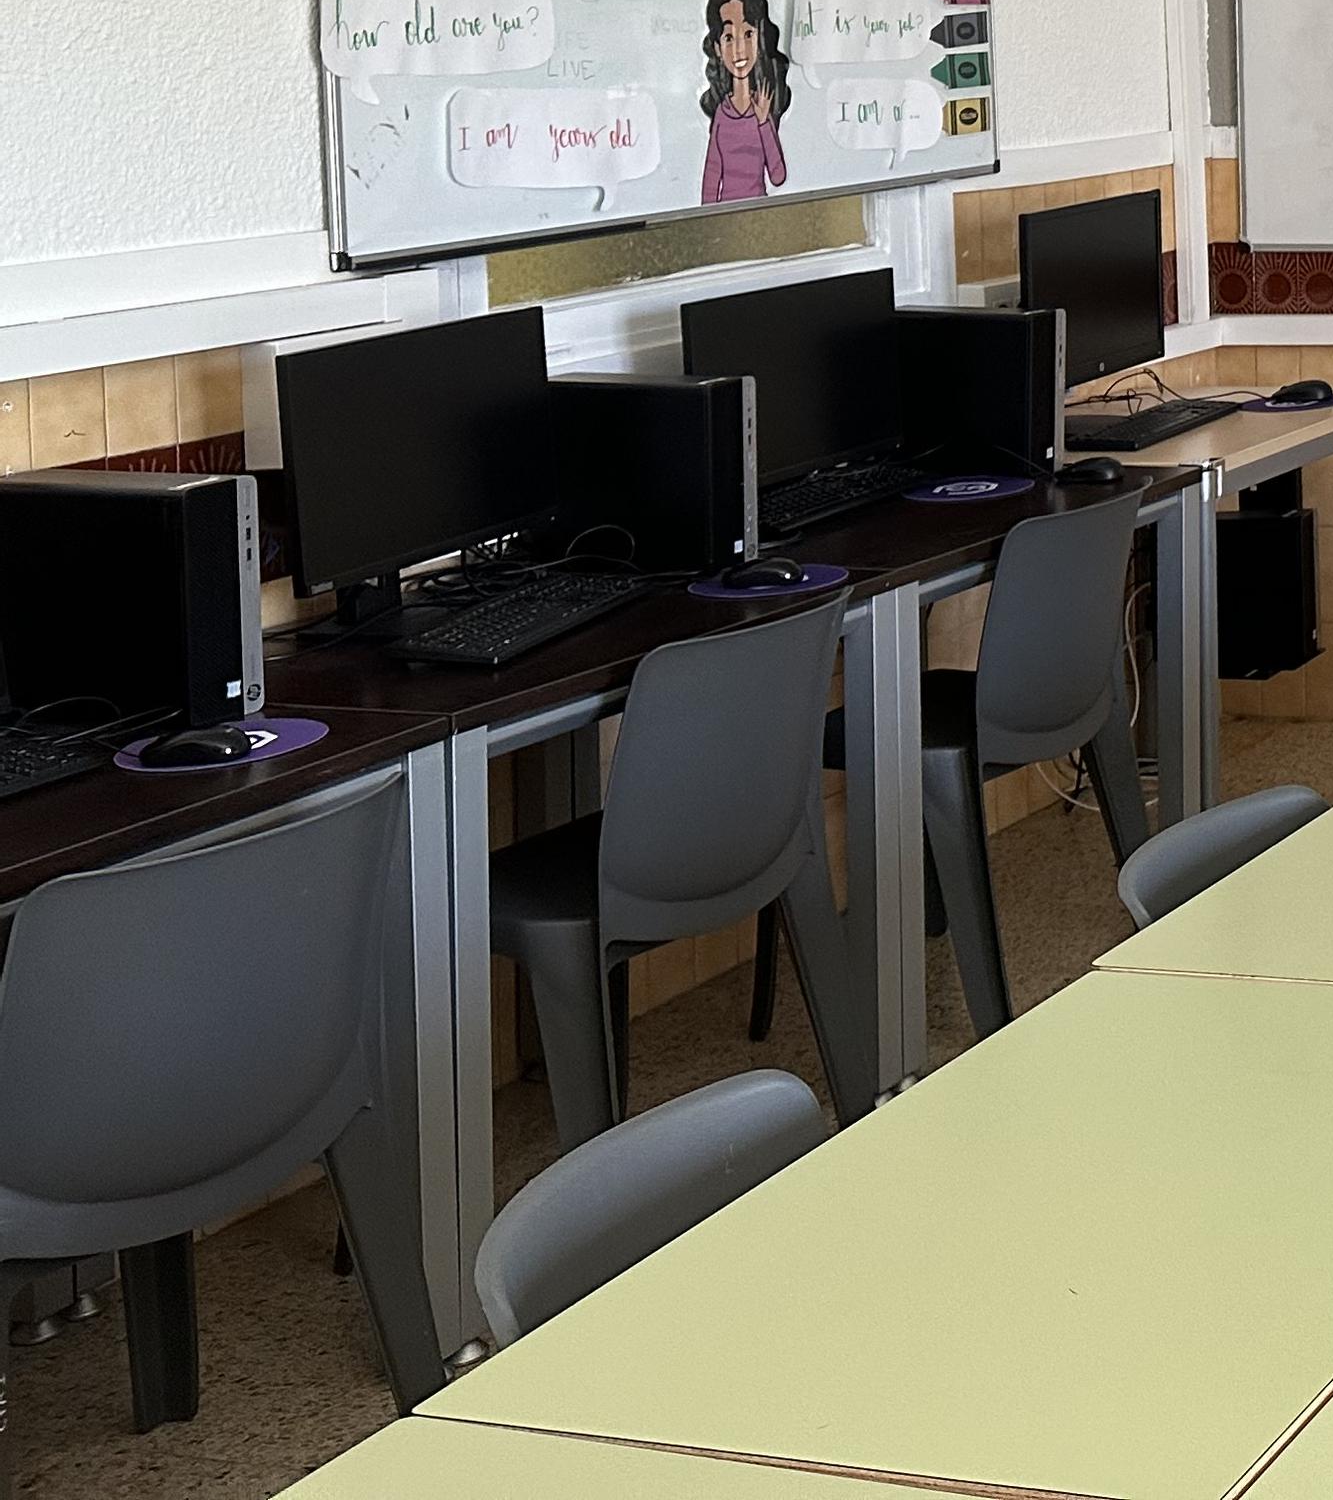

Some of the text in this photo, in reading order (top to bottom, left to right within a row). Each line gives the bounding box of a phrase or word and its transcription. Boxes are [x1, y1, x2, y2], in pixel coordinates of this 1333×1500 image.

[452, 17, 486, 38] are
[492, 6, 540, 52] you?
[832, 9, 857, 34] is
[547, 58, 595, 80] LIVE
[836, 102, 850, 124] I
[857, 100, 884, 126] am
[458, 126, 471, 151] I
[486, 122, 519, 149] am
[609, 118, 639, 149] old
